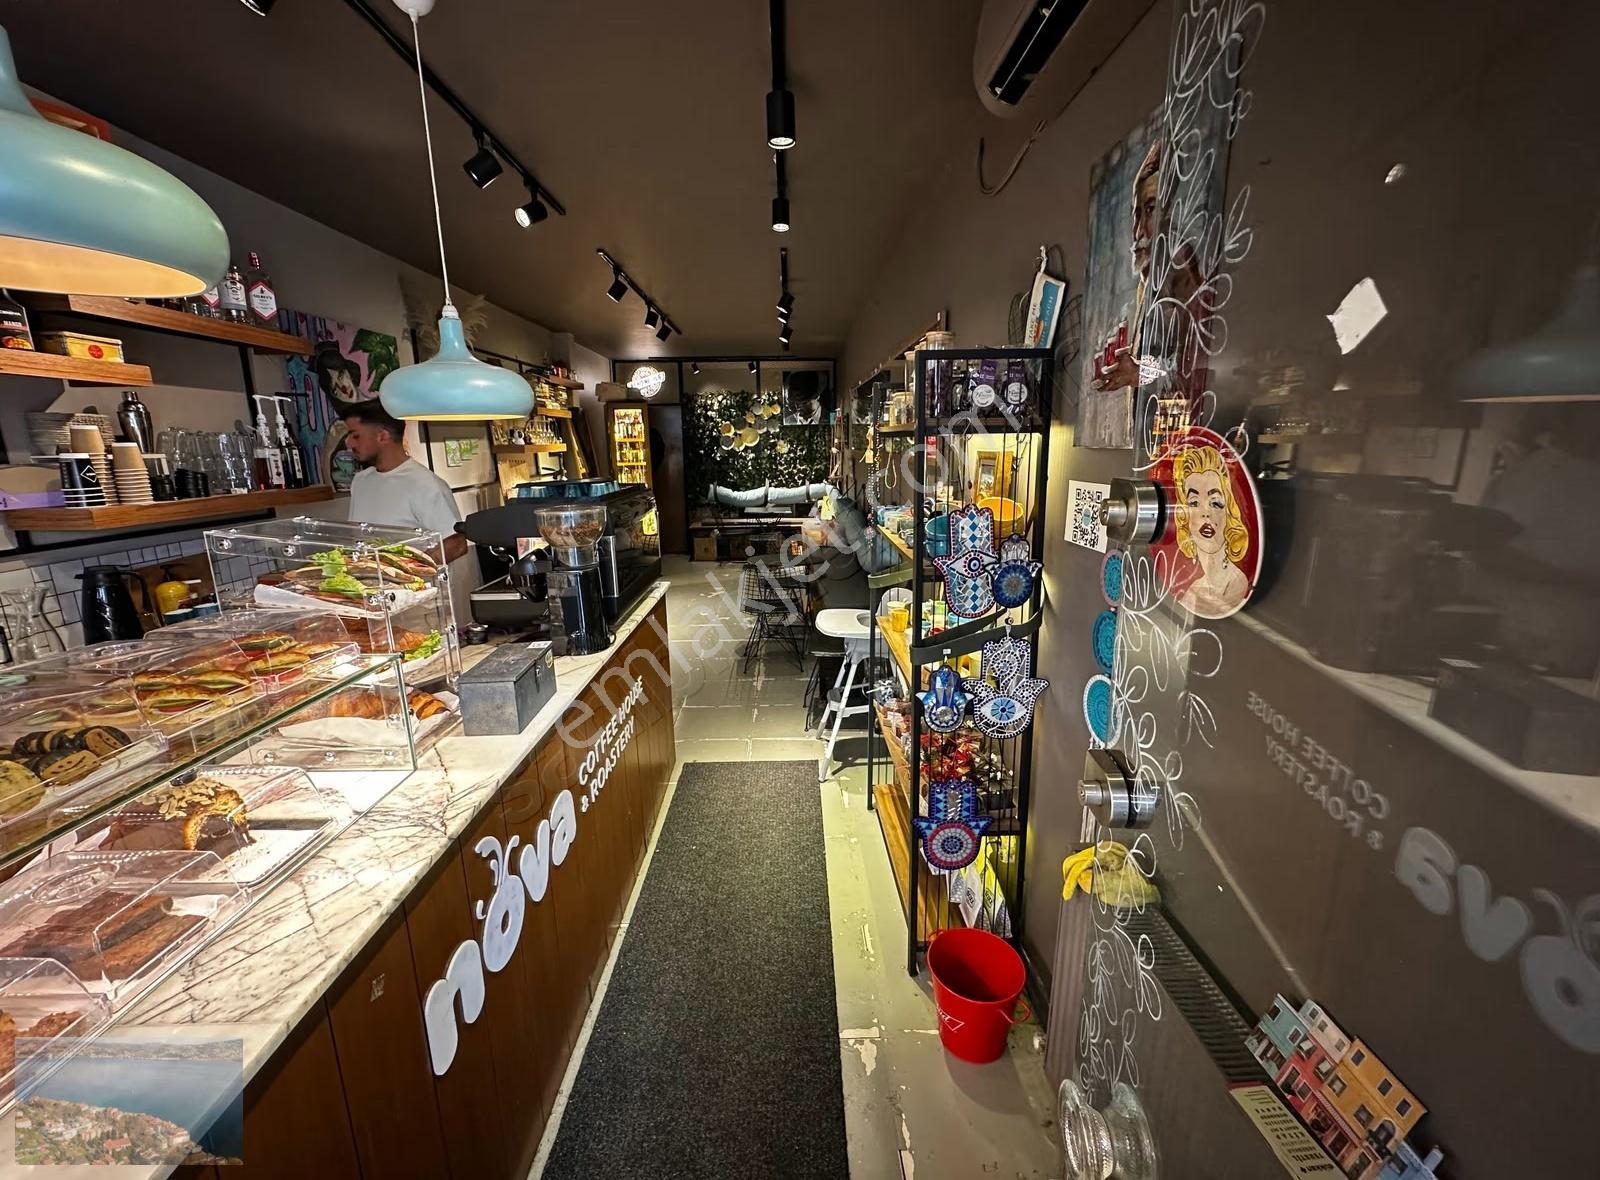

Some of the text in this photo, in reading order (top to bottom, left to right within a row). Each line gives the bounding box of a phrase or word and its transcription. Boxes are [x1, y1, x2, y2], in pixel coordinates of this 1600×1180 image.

[618, 675, 643, 724] HOUSE
[581, 716, 635, 813] & ROASTERY
